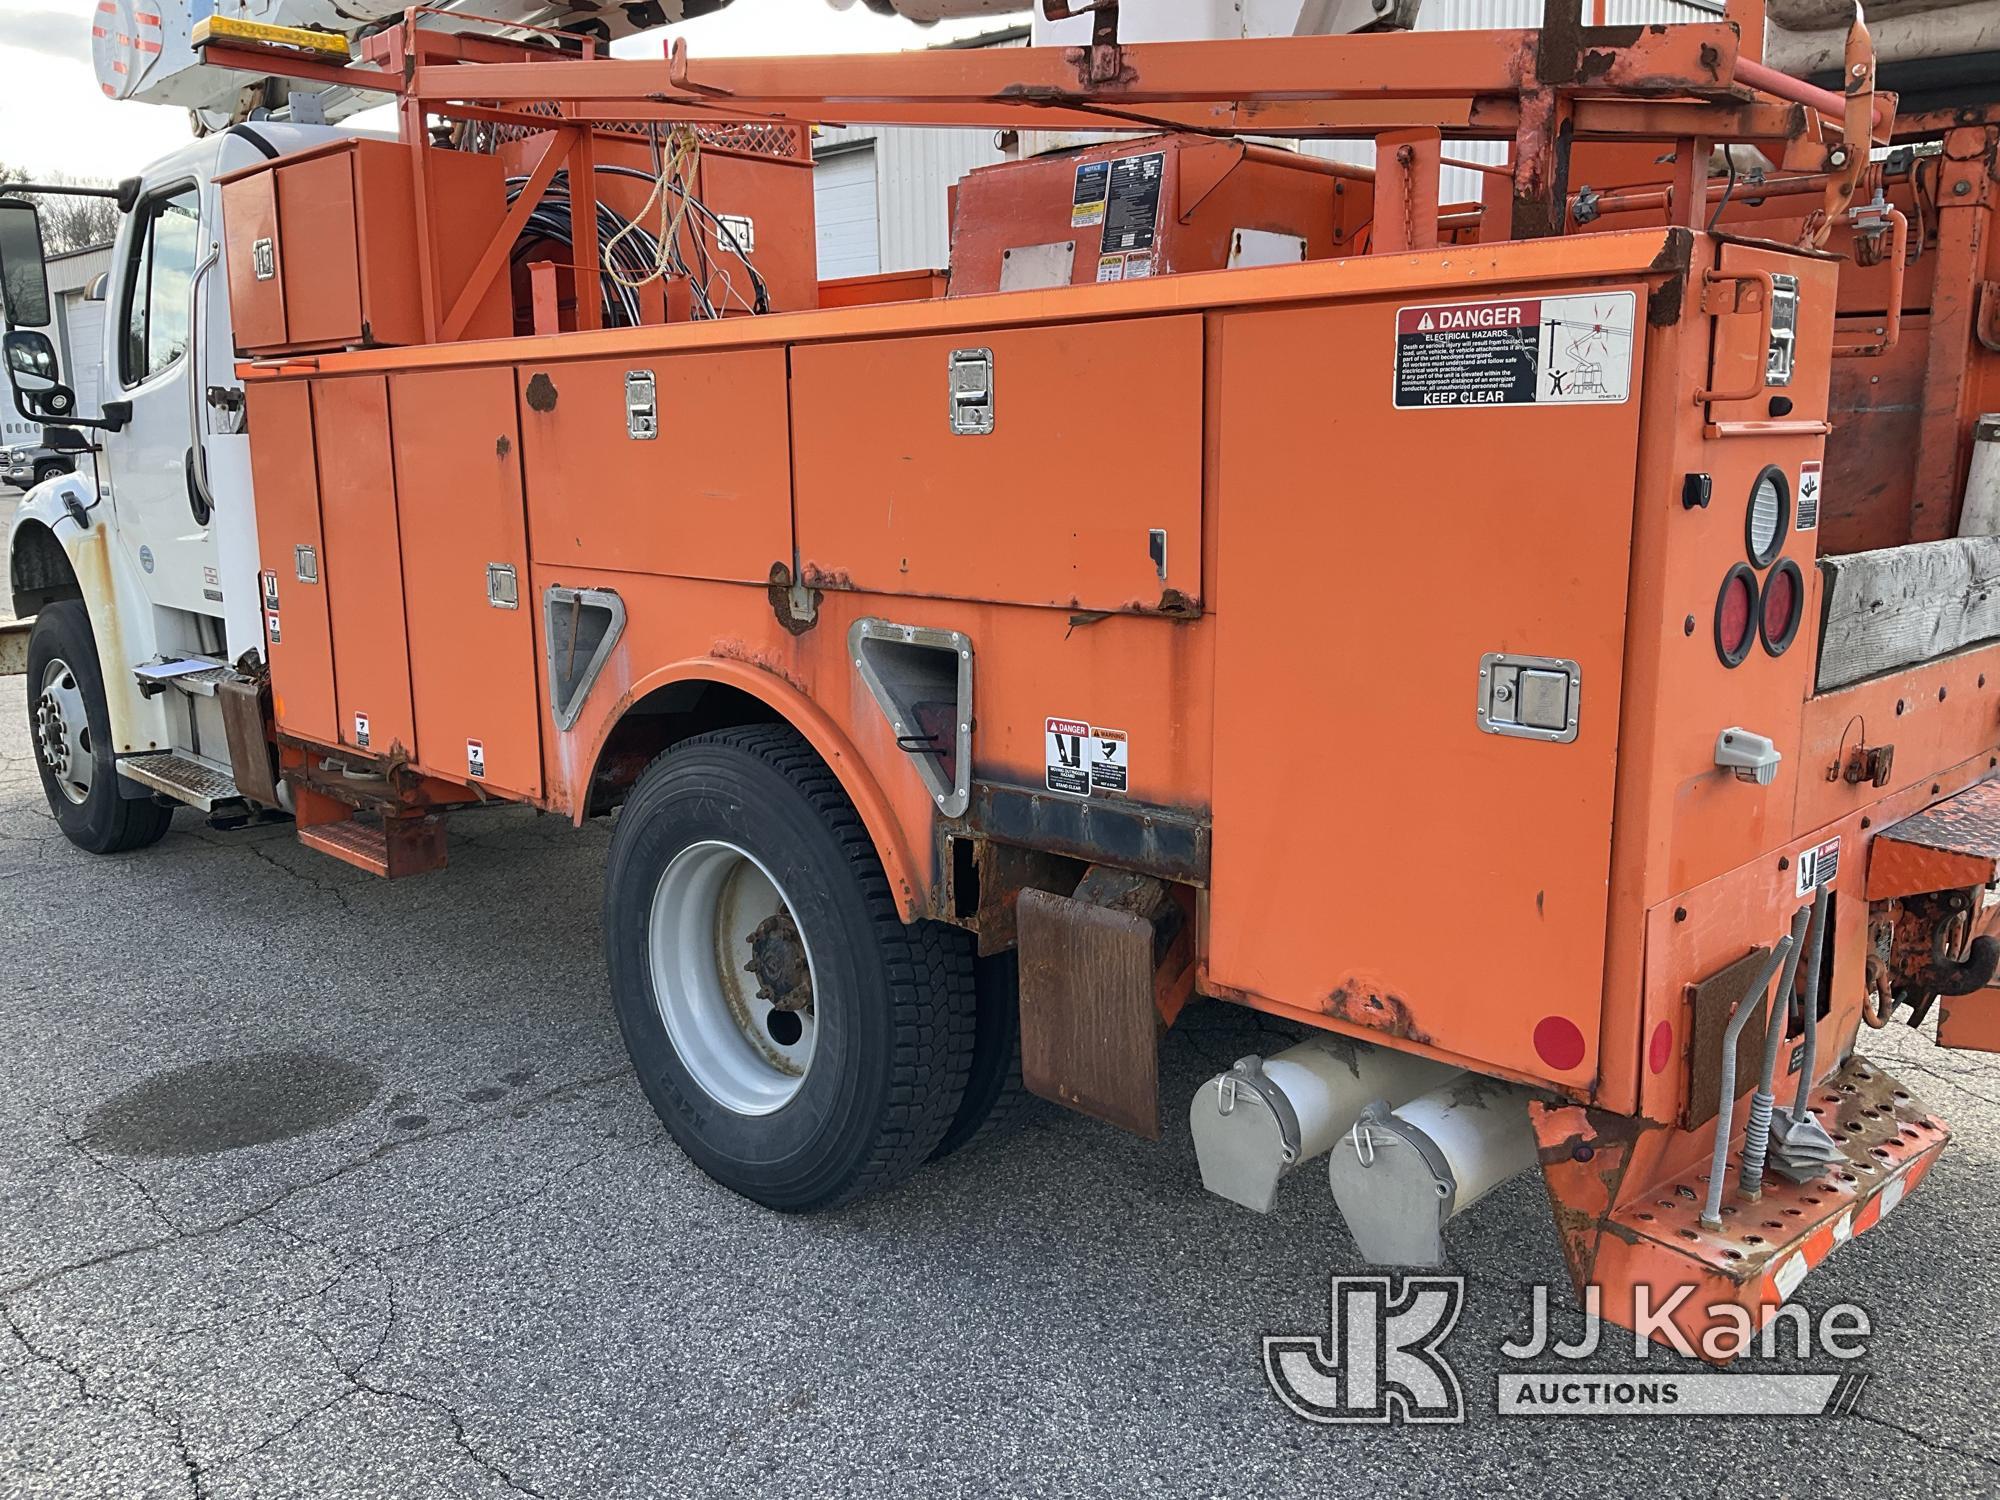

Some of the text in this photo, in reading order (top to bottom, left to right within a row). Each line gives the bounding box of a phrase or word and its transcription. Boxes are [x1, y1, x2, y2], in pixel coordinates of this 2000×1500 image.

[1085, 165, 1101, 173] NOTICE
[1440, 307, 1521, 329] DANGER
[1425, 330, 1508, 341] ELECTRICAL HAZARDS
[1446, 341, 1461, 351] injury
[1489, 339, 1501, 347] from
[1445, 358, 1476, 366] understand
[1487, 356, 1505, 364] follow
[1426, 379, 1450, 387] approach
[1489, 376, 1516, 384] energized
[1436, 383, 1471, 391] unauthorized
[1471, 383, 1499, 391] personnel
[1423, 390, 1504, 405] KEEP CLEAR
[1059, 723, 1086, 735] DANGER
[1100, 731, 1125, 740] WARNING
